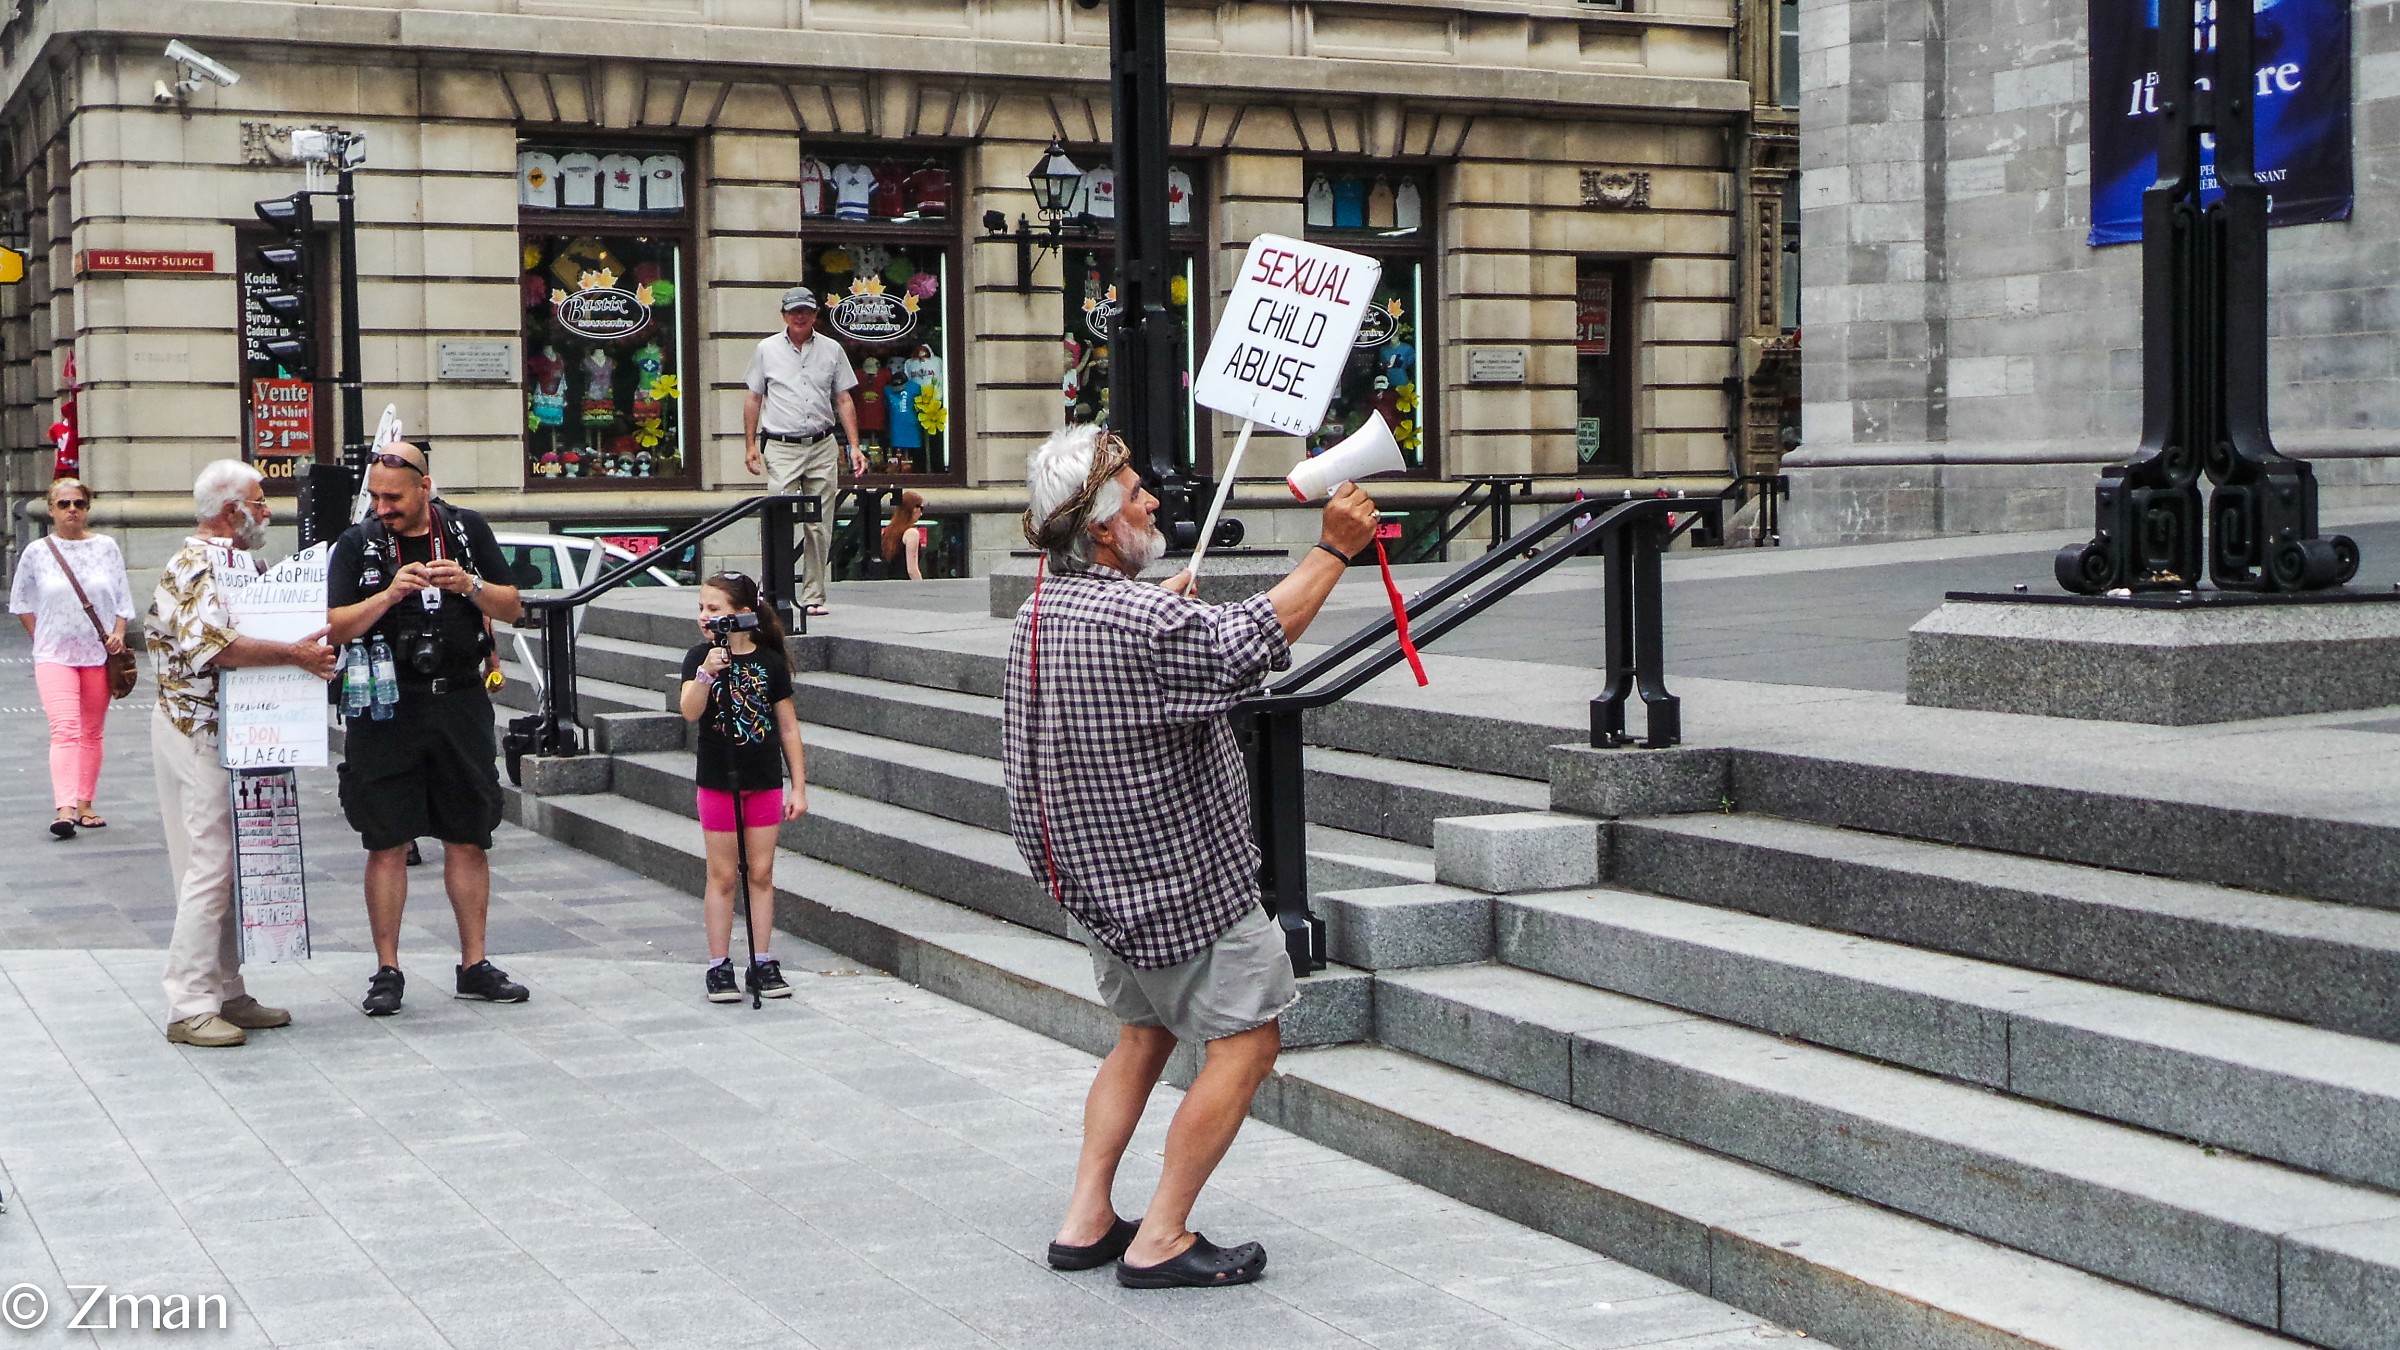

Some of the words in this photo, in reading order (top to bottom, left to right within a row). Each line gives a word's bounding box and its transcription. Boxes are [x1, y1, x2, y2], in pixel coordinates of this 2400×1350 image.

[99, 256, 121, 266] RUE
[244, 273, 279, 285] Kodak
[1251, 248, 1350, 306] SEXUAL
[567, 295, 629, 323] Bastix
[839, 299, 897, 327] Bastix
[245, 311, 272, 326] Syrop
[577, 317, 634, 328] souvenirs
[849, 321, 901, 331] souvenirs
[245, 324, 278, 337] Cadeaux
[256, 382, 308, 402] Vente
[257, 403, 269, 419] 3
[253, 458, 298, 478] Kod
